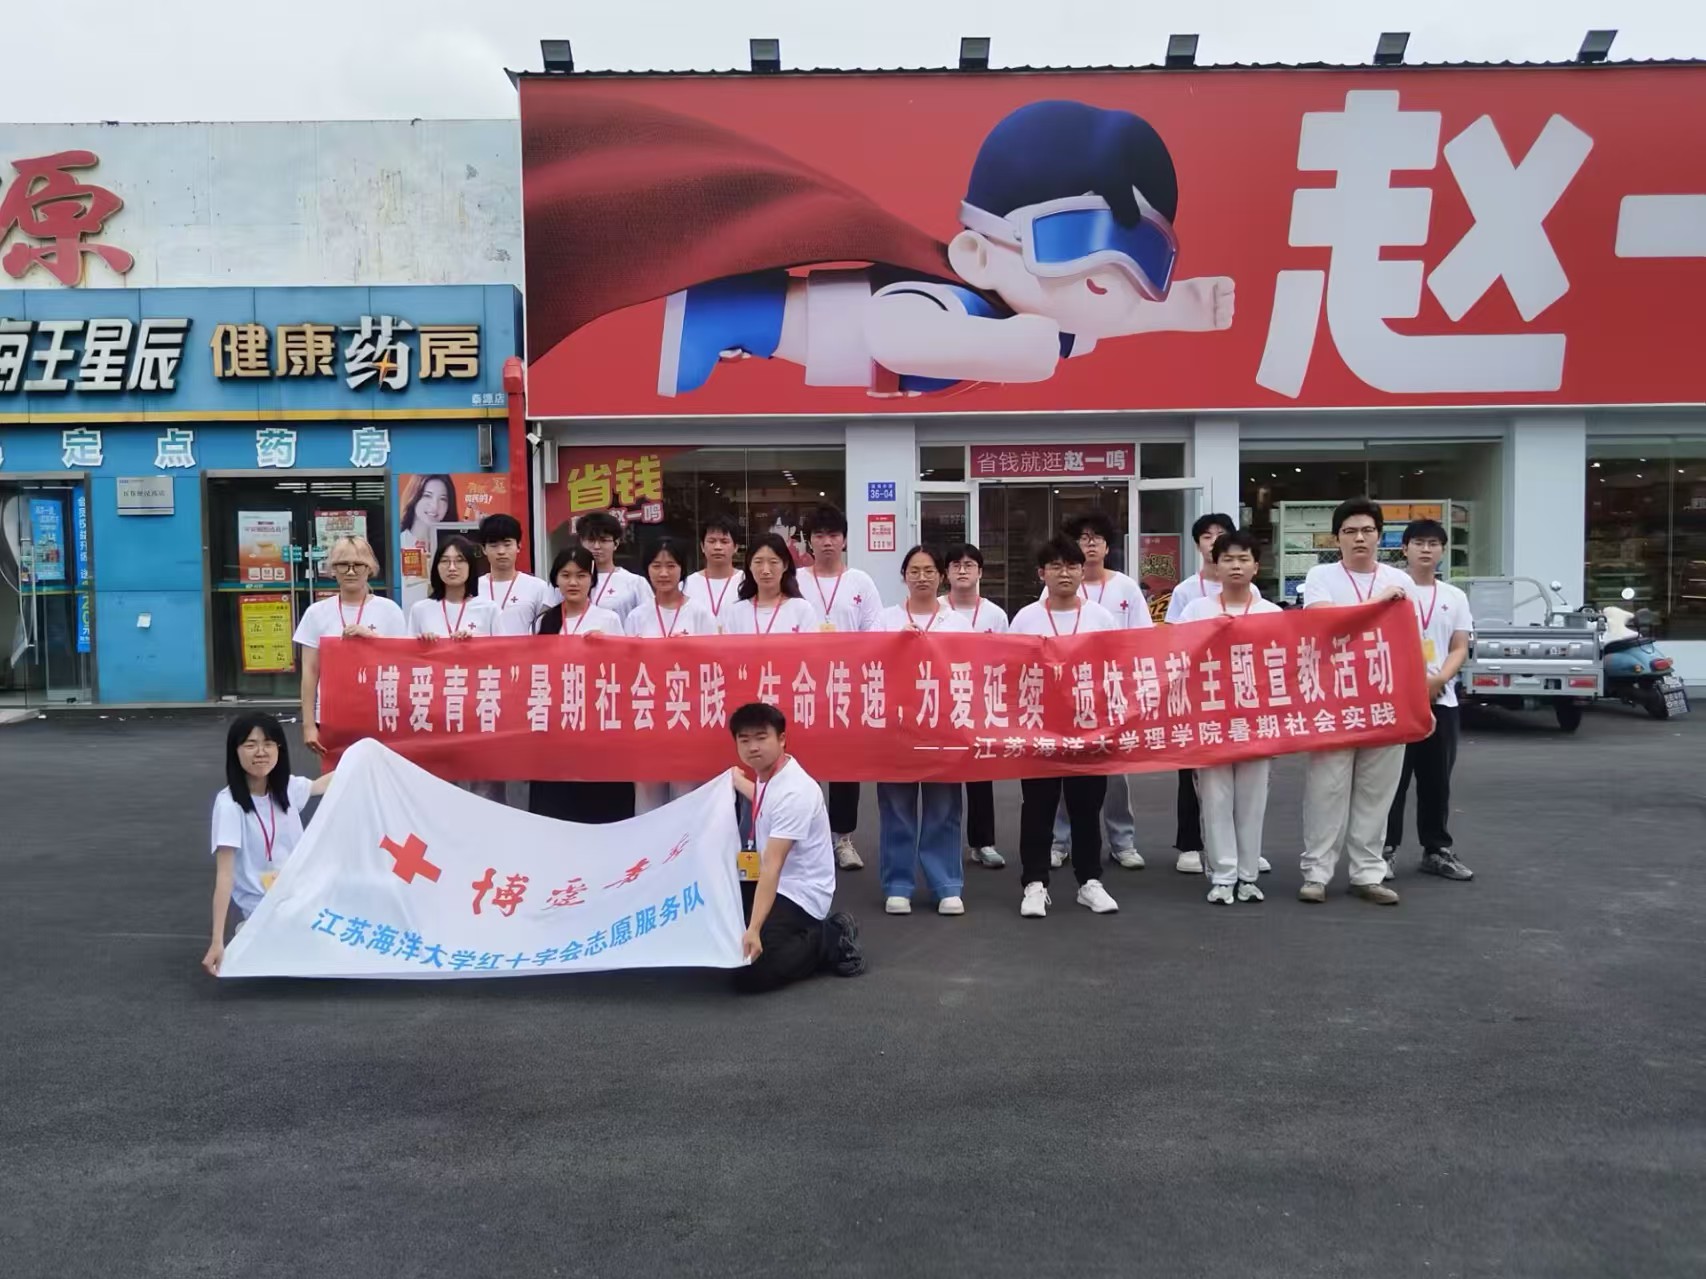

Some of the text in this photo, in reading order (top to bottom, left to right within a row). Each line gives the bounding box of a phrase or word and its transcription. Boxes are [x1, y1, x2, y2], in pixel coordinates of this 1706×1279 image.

[209, 315, 479, 390] 健康药房
[568, 454, 663, 513] 省钱
[976, 449, 1127, 474] 省钱就逛赵一鸣
[870, 489, 893, 499] 36-04
[310, 880, 705, 970] 江苏海洋大学红十字会志愿服务队
